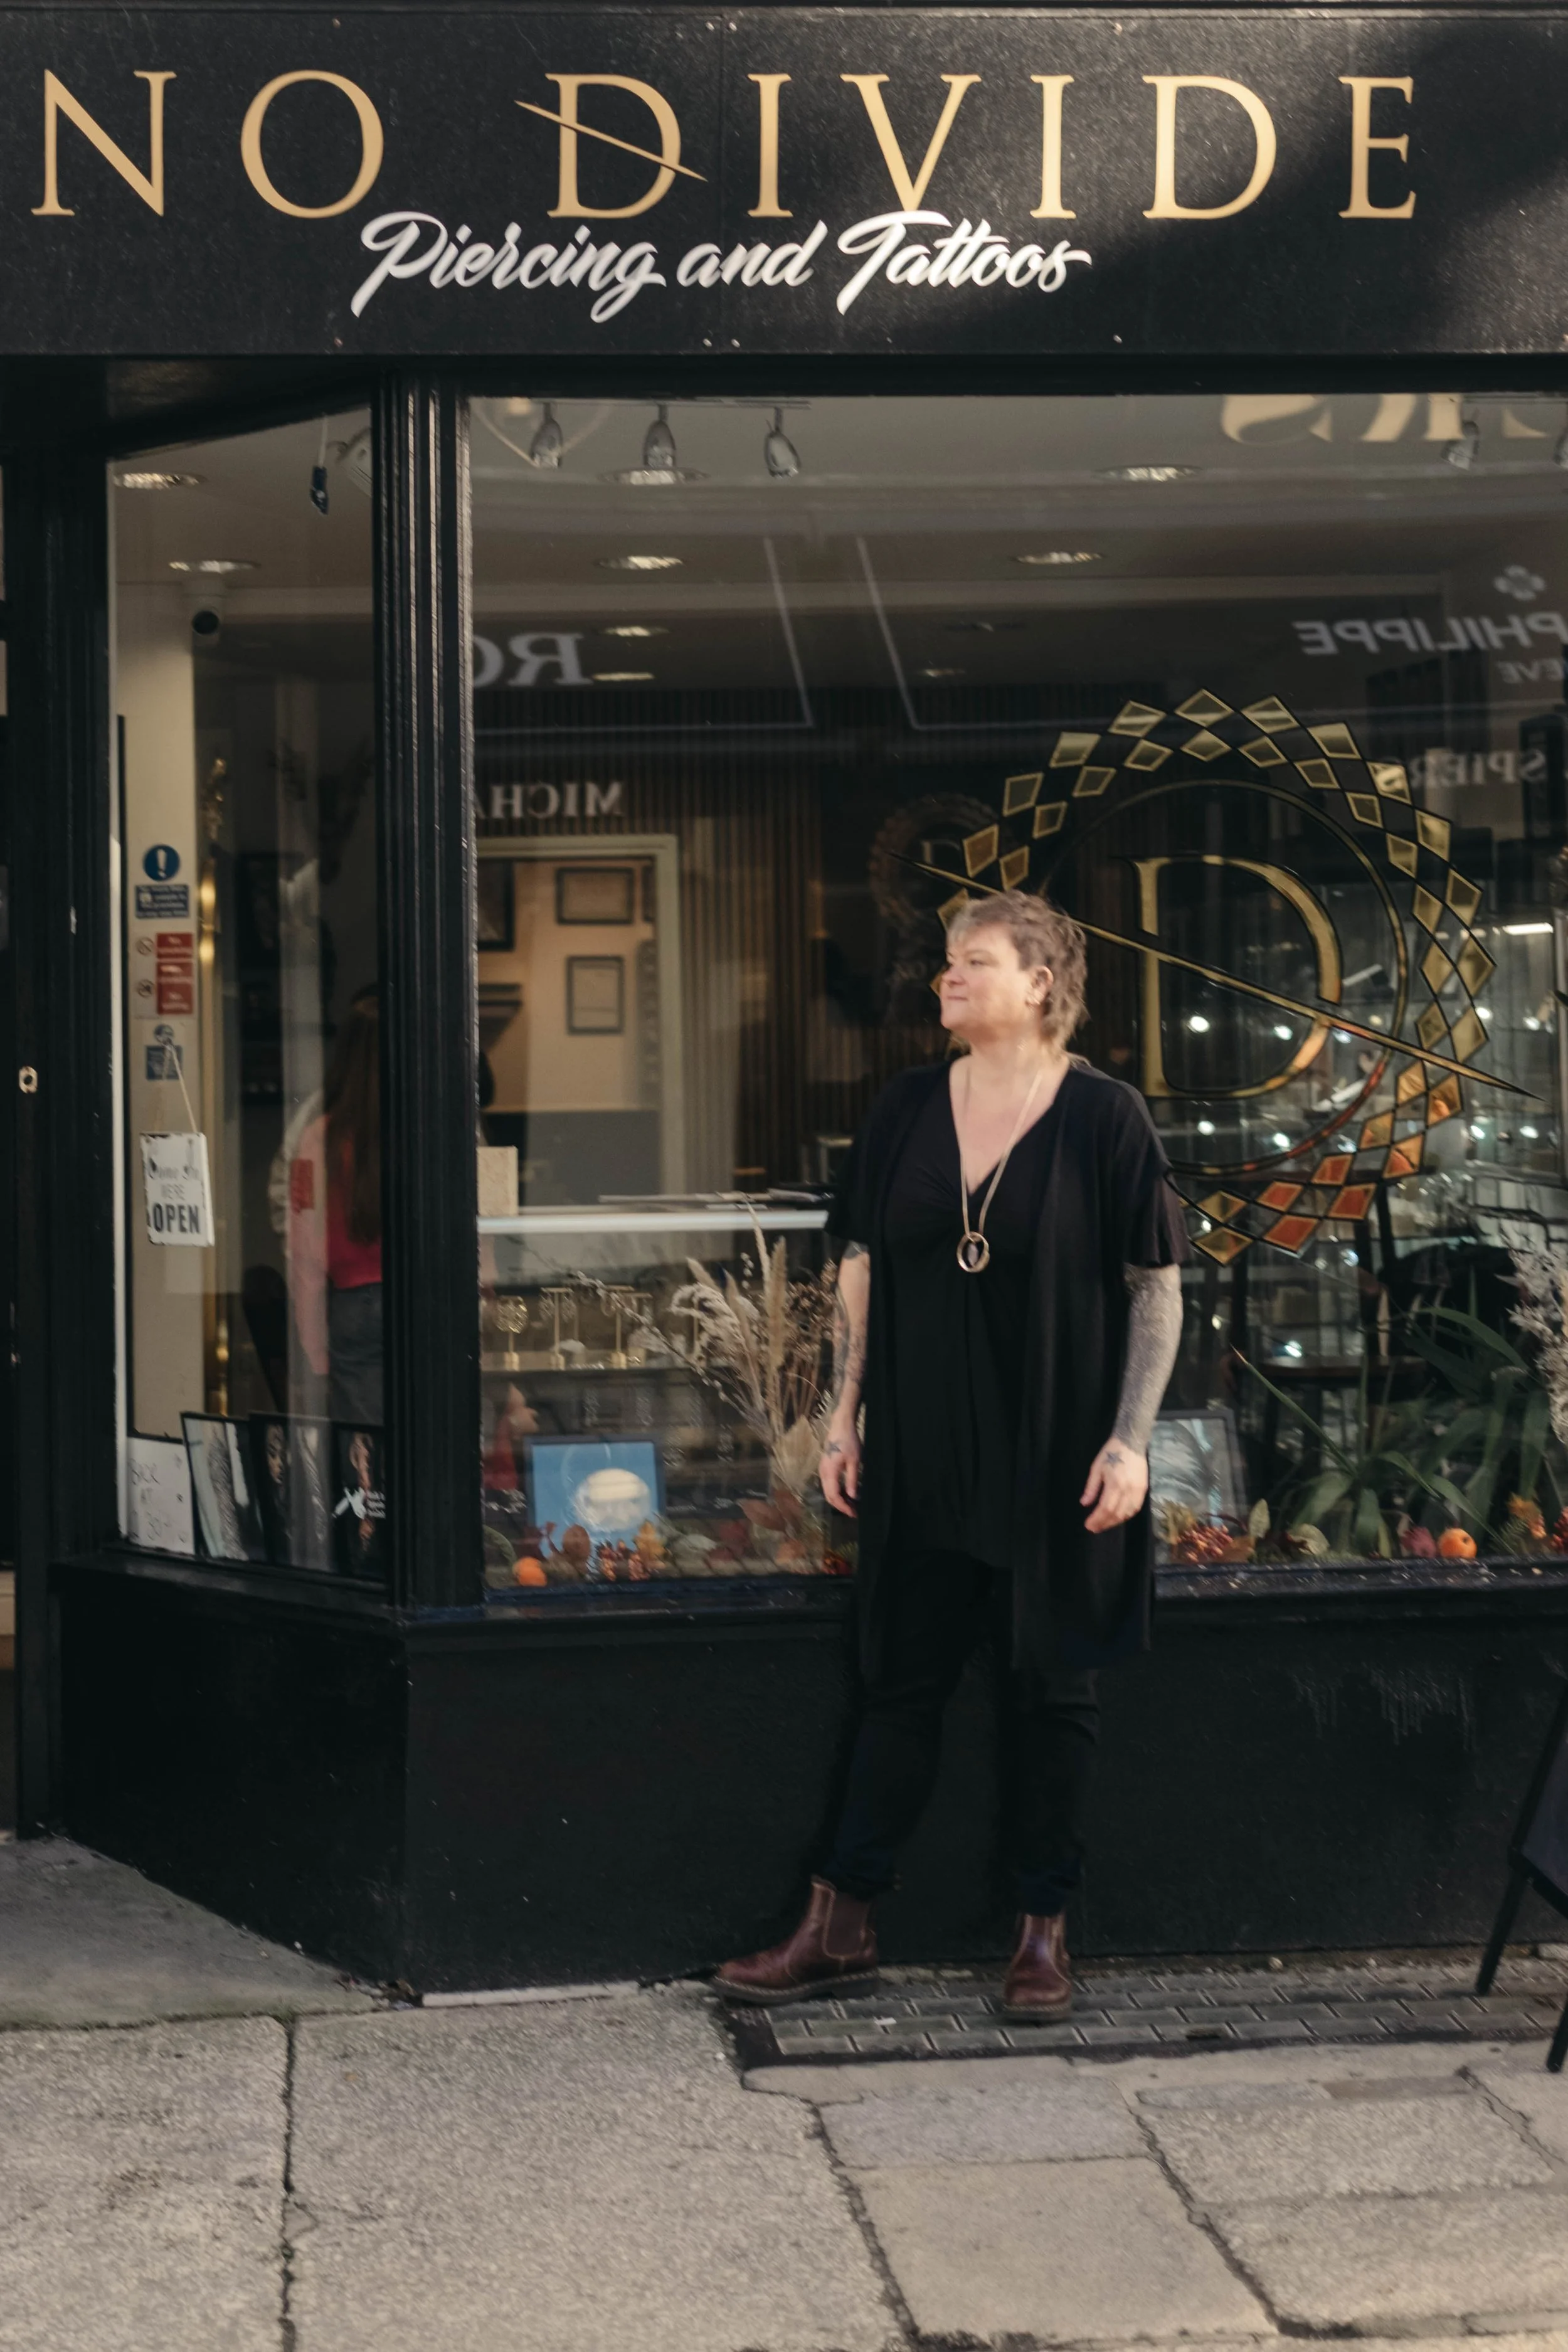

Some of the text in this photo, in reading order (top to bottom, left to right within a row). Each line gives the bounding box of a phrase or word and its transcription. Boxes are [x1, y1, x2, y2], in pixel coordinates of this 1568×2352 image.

[31, 68, 1416, 218] NO DIVIDE
[350, 210, 1092, 323] Piercing and Tattoos
[152, 1202, 200, 1234] OPEN
